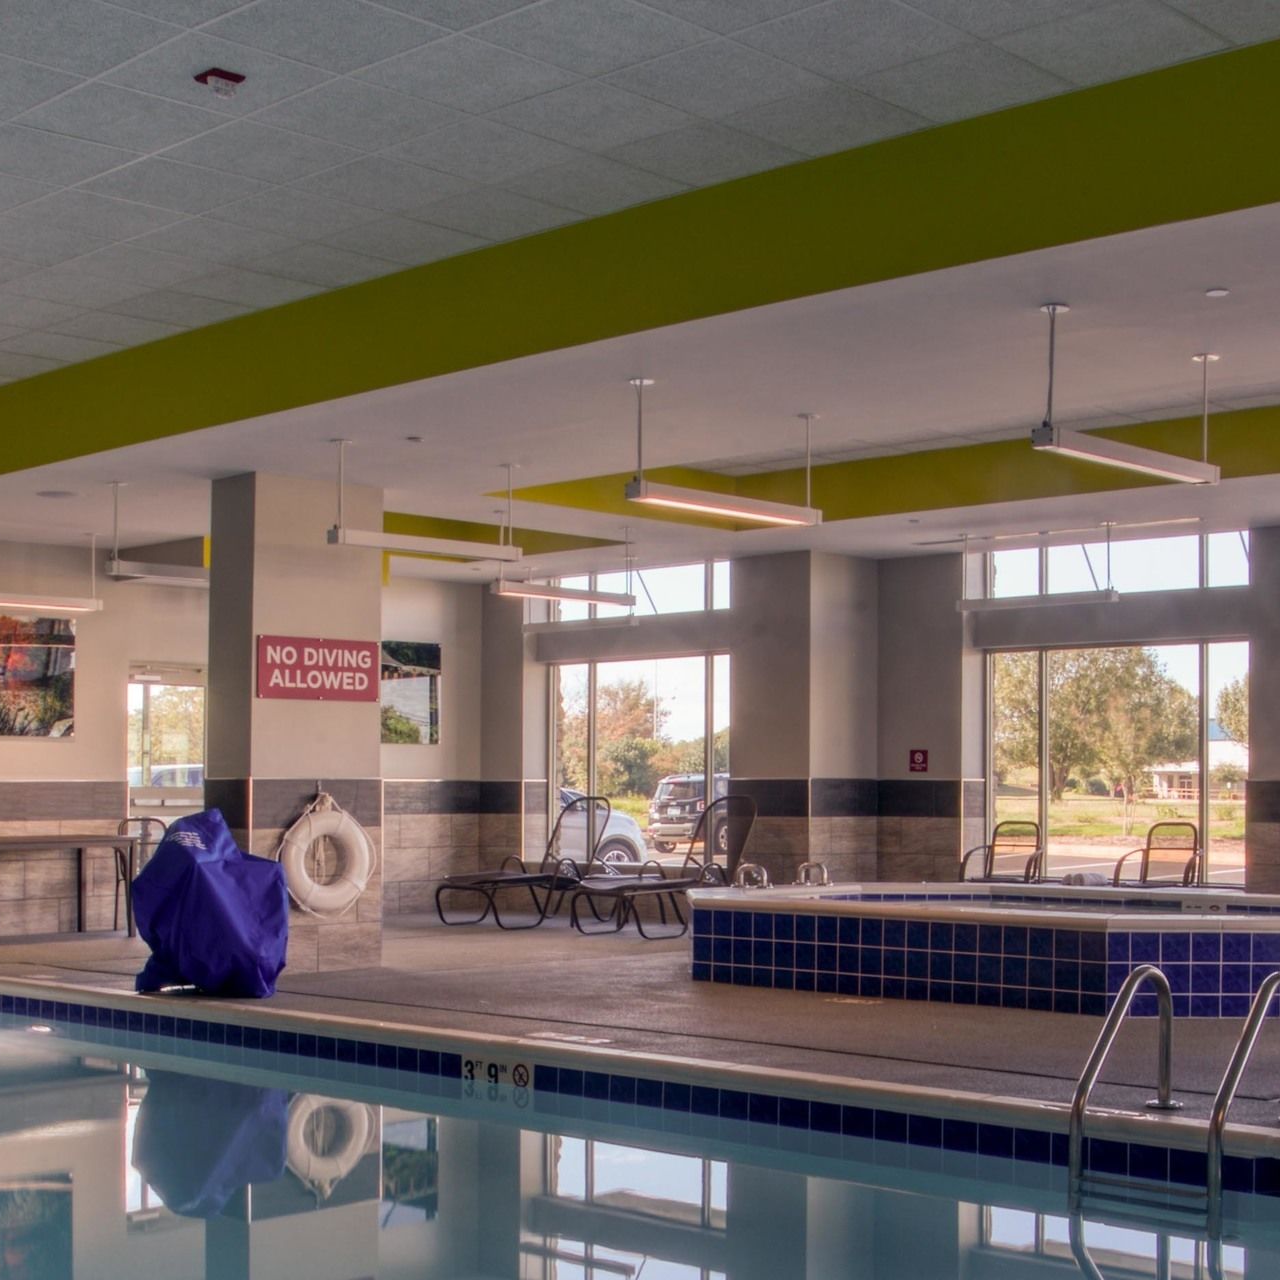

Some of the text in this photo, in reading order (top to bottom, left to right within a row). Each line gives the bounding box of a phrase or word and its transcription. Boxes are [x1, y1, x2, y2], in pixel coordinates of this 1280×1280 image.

[266, 645, 372, 669] NO DIVING
[268, 668, 369, 691] ALLOWED
[464, 1060, 475, 1081] 3
[487, 1063, 499, 1084] 9
